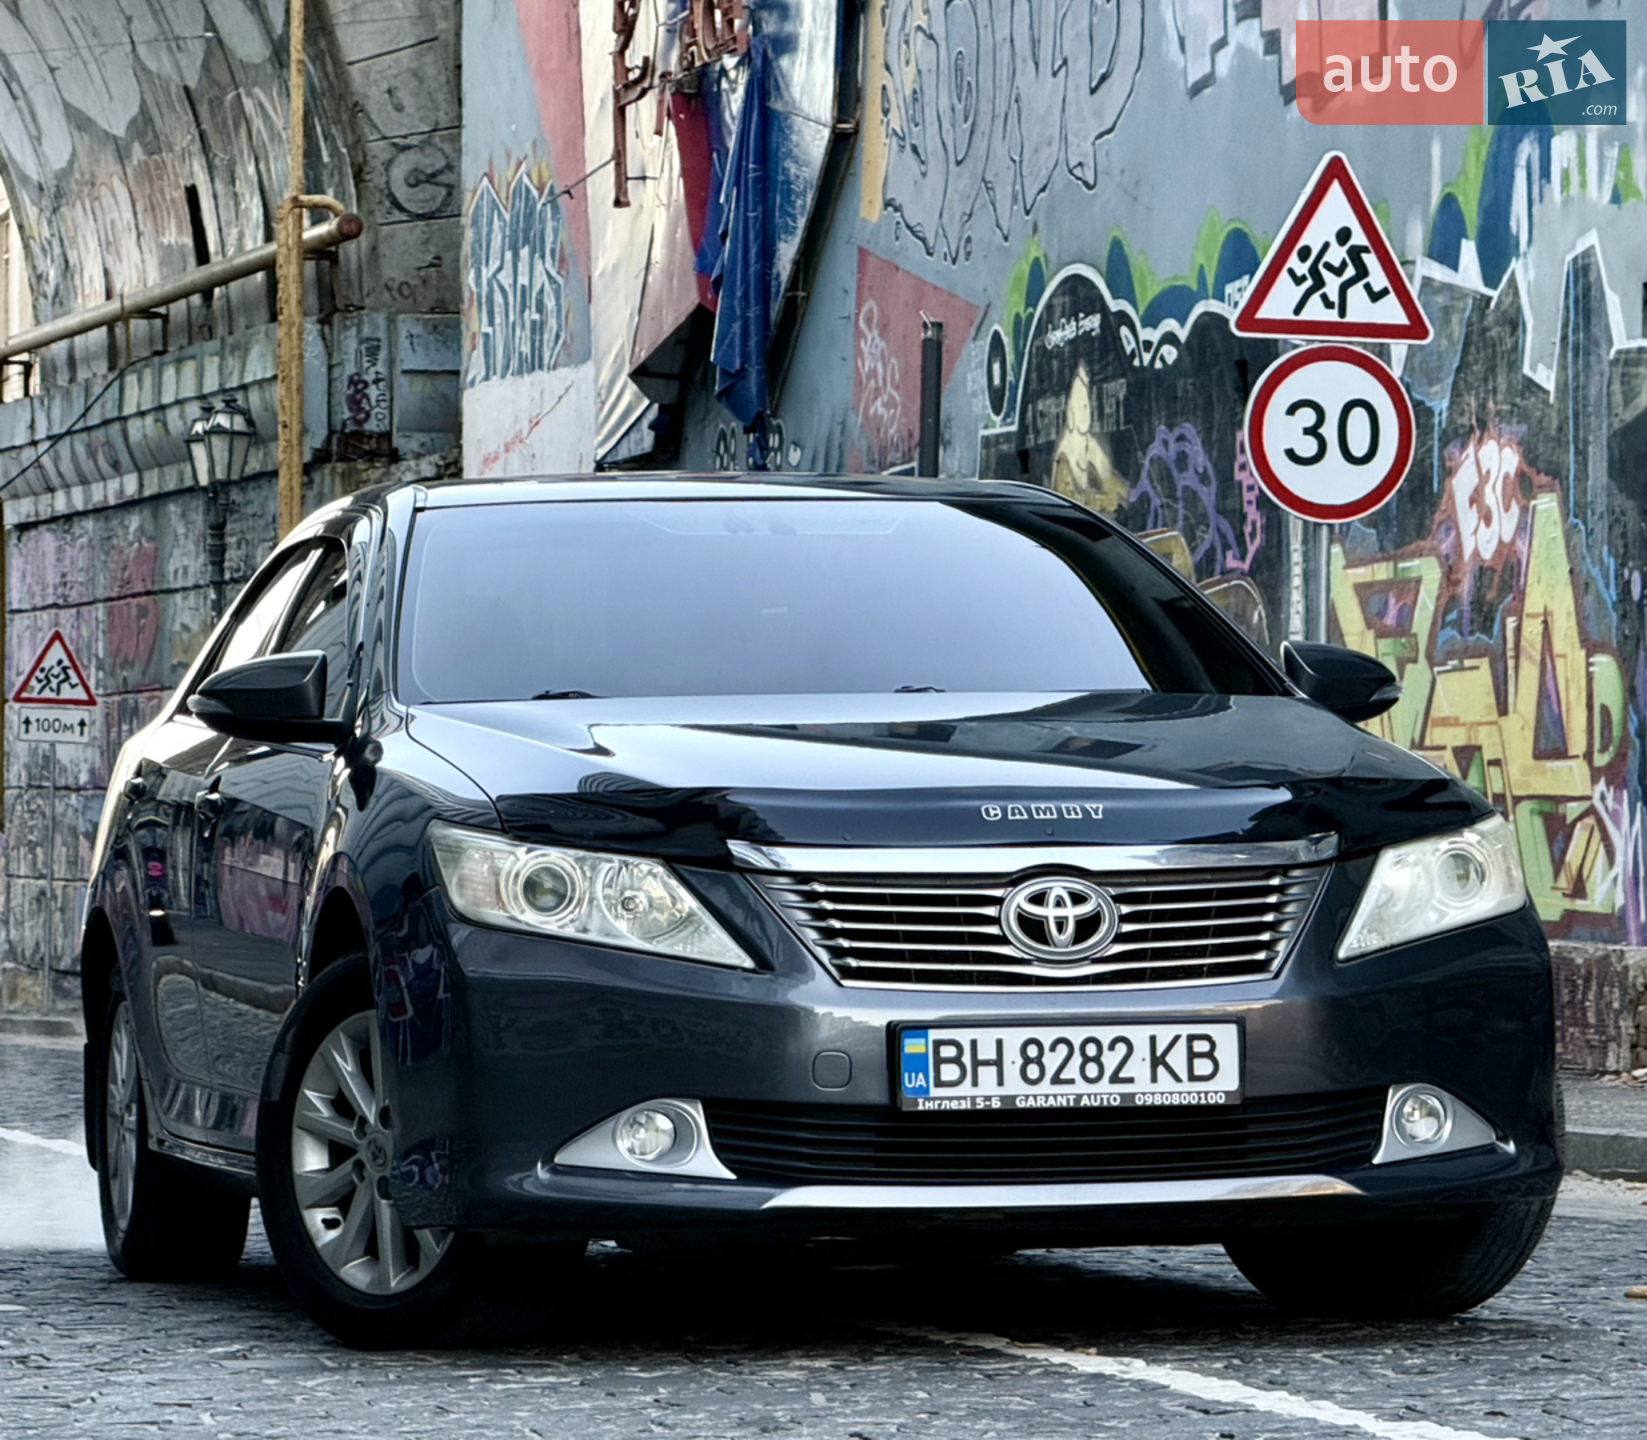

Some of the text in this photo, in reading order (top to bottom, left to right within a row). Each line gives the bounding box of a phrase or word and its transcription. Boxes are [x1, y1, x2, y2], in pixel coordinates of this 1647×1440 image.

[1283, 398, 1382, 467] 30
[981, 803, 1104, 820] CAMRY
[931, 1033, 1220, 1088] BH 8282 KB
[904, 1073, 928, 1088] UA
[1015, 1095, 1078, 1108] GARANT
[1080, 1095, 1121, 1106] AUTO
[1135, 1092, 1226, 1105] 0980800100
